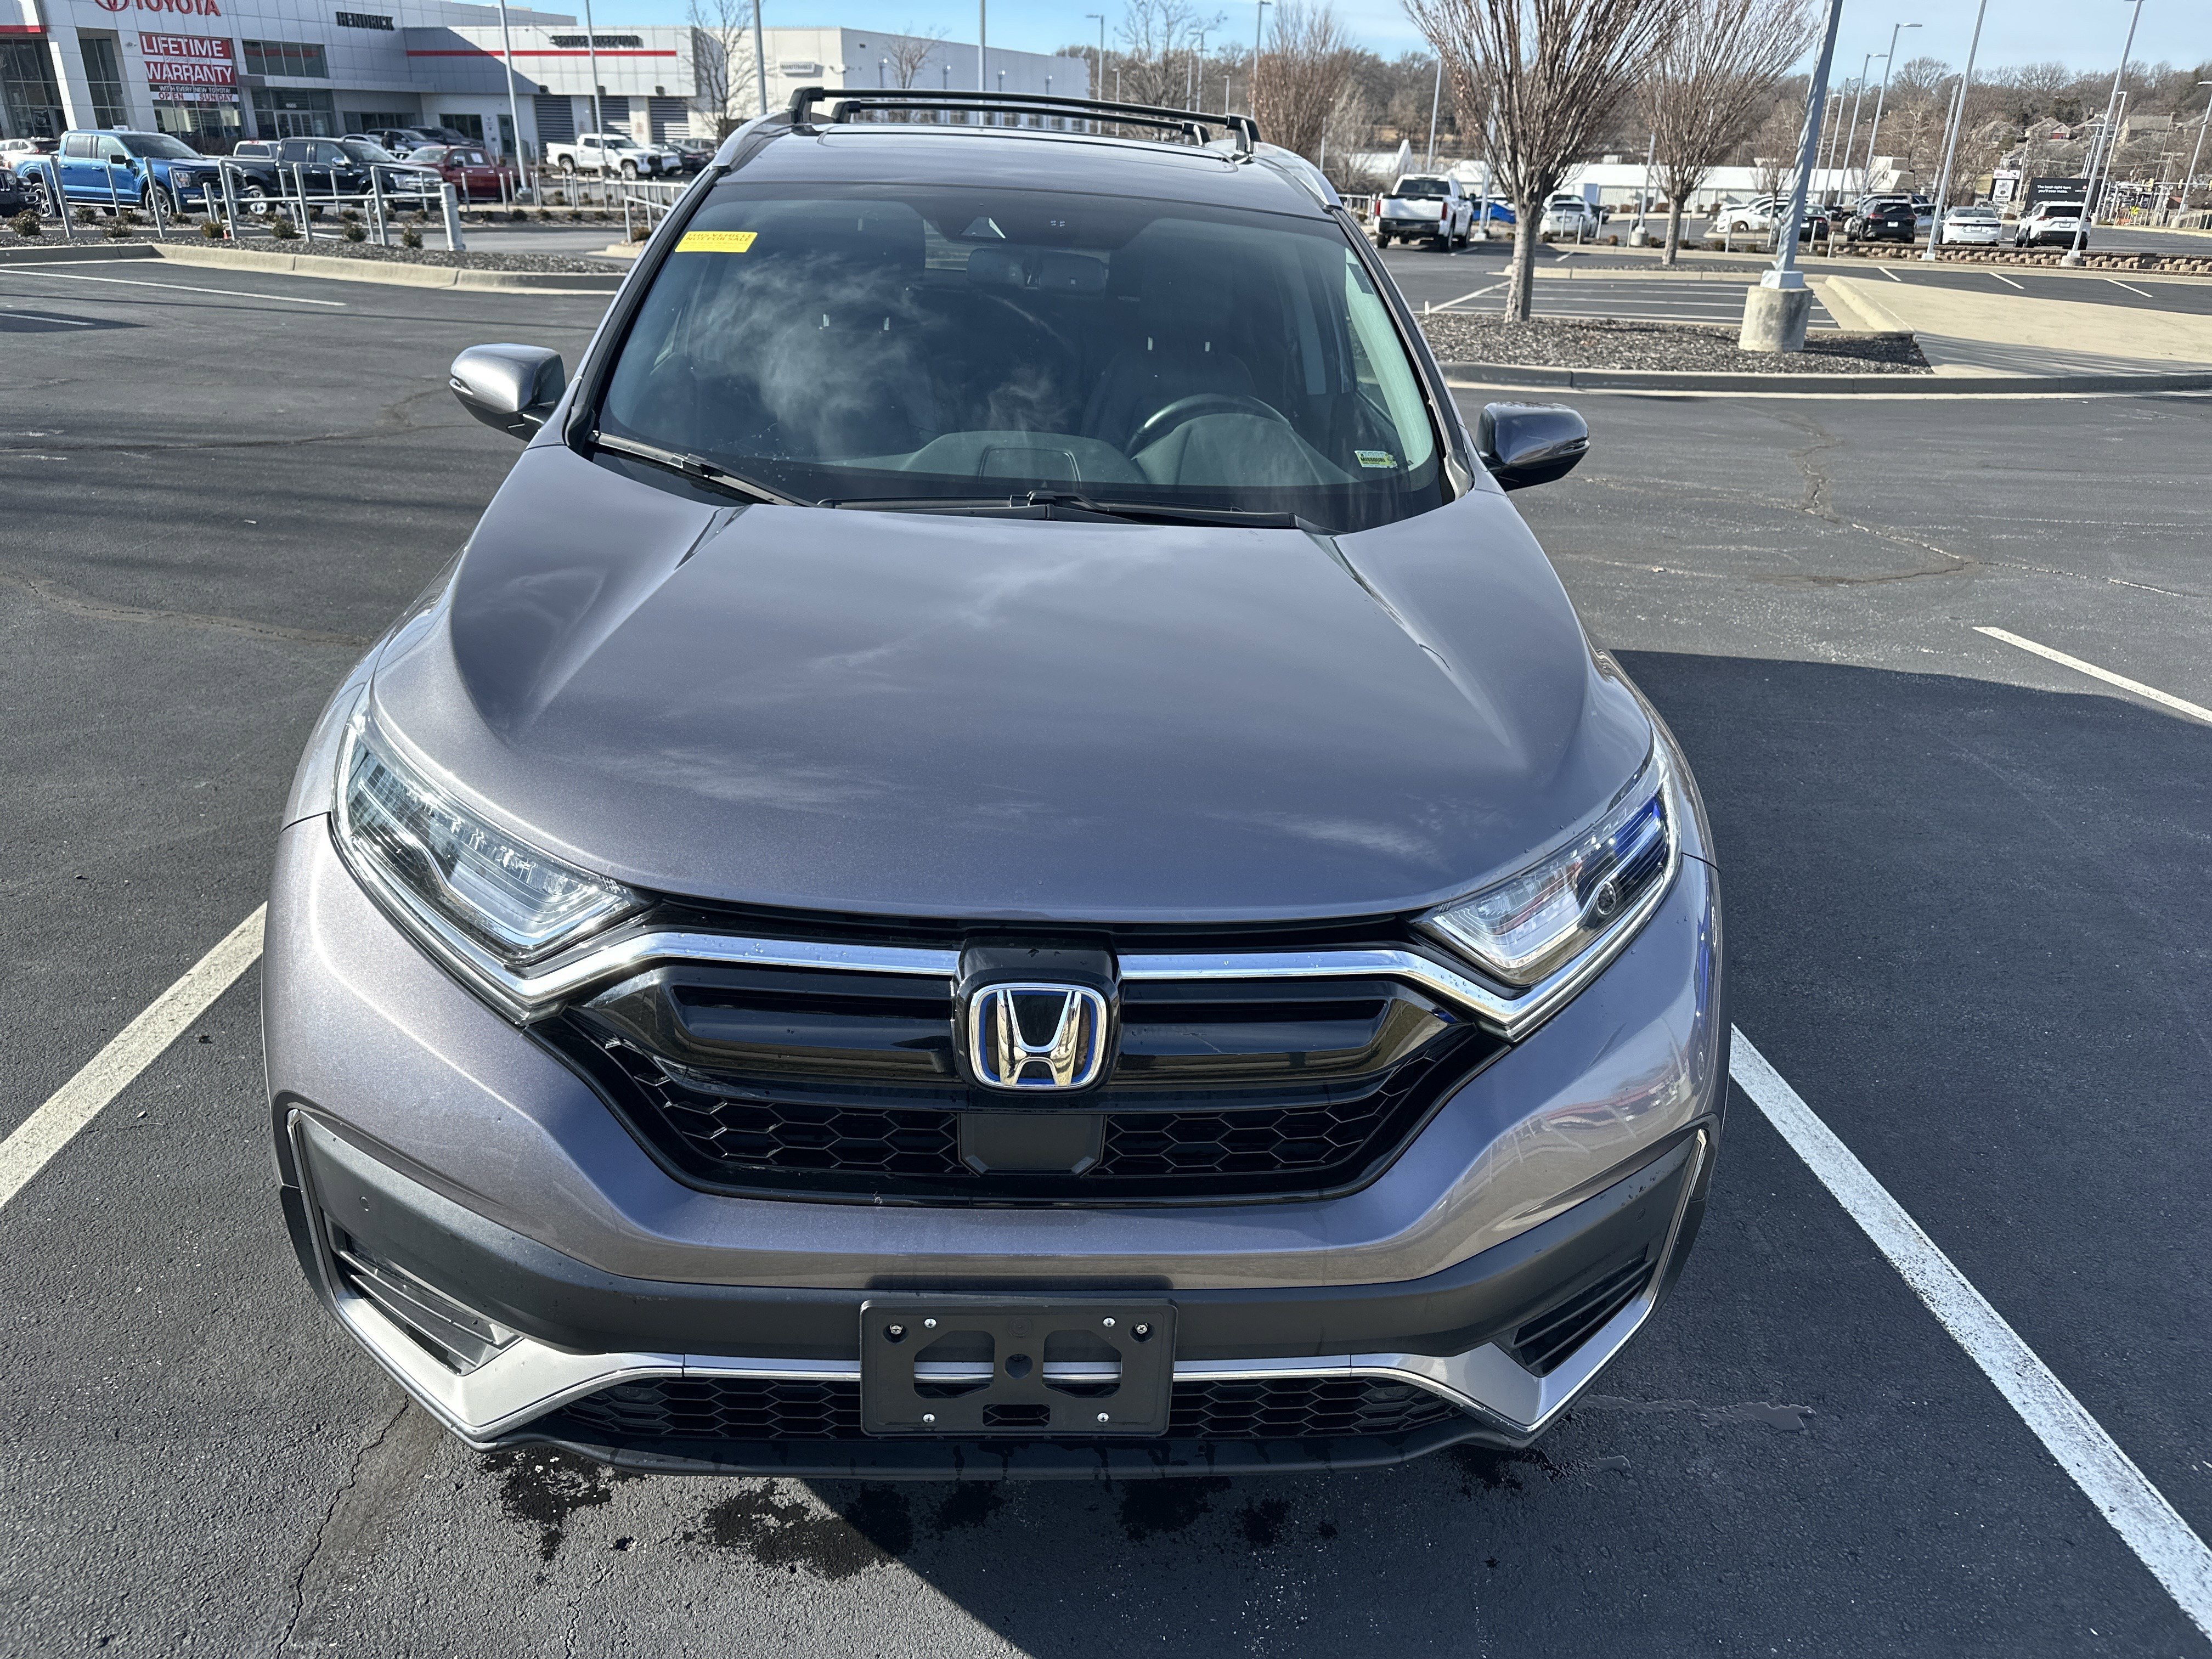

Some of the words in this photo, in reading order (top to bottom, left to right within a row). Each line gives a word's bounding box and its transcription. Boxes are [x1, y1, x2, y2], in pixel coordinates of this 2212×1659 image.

[336, 12, 394, 31] HENDRICK
[142, 35, 224, 57] LIFETIME
[146, 63, 233, 83] WARRANTY
[159, 92, 184, 100] OPEN
[199, 93, 233, 102] SUNDAY
